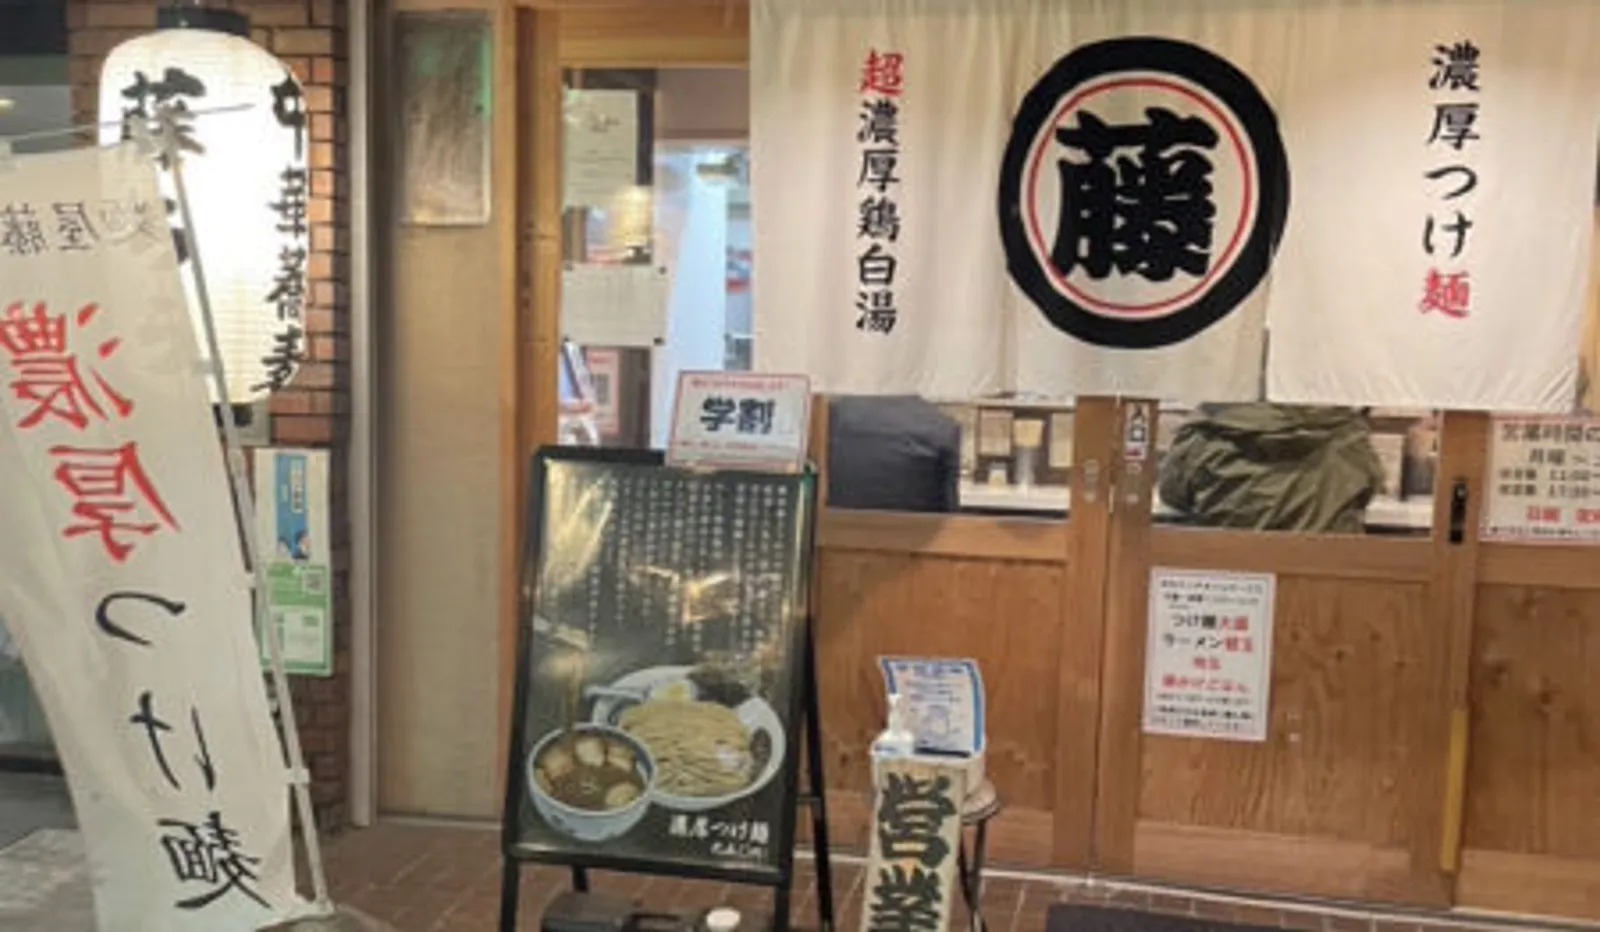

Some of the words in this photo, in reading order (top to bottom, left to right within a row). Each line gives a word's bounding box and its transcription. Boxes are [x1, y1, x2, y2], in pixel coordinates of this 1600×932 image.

[855, 48, 904, 334] 超濃厚鶏白湯
[1051, 106, 1220, 282] 藤
[1419, 39, 1481, 319] 濃厚つけ麺
[700, 394, 775, 434] 学割
[869, 771, 957, 932] 営業
